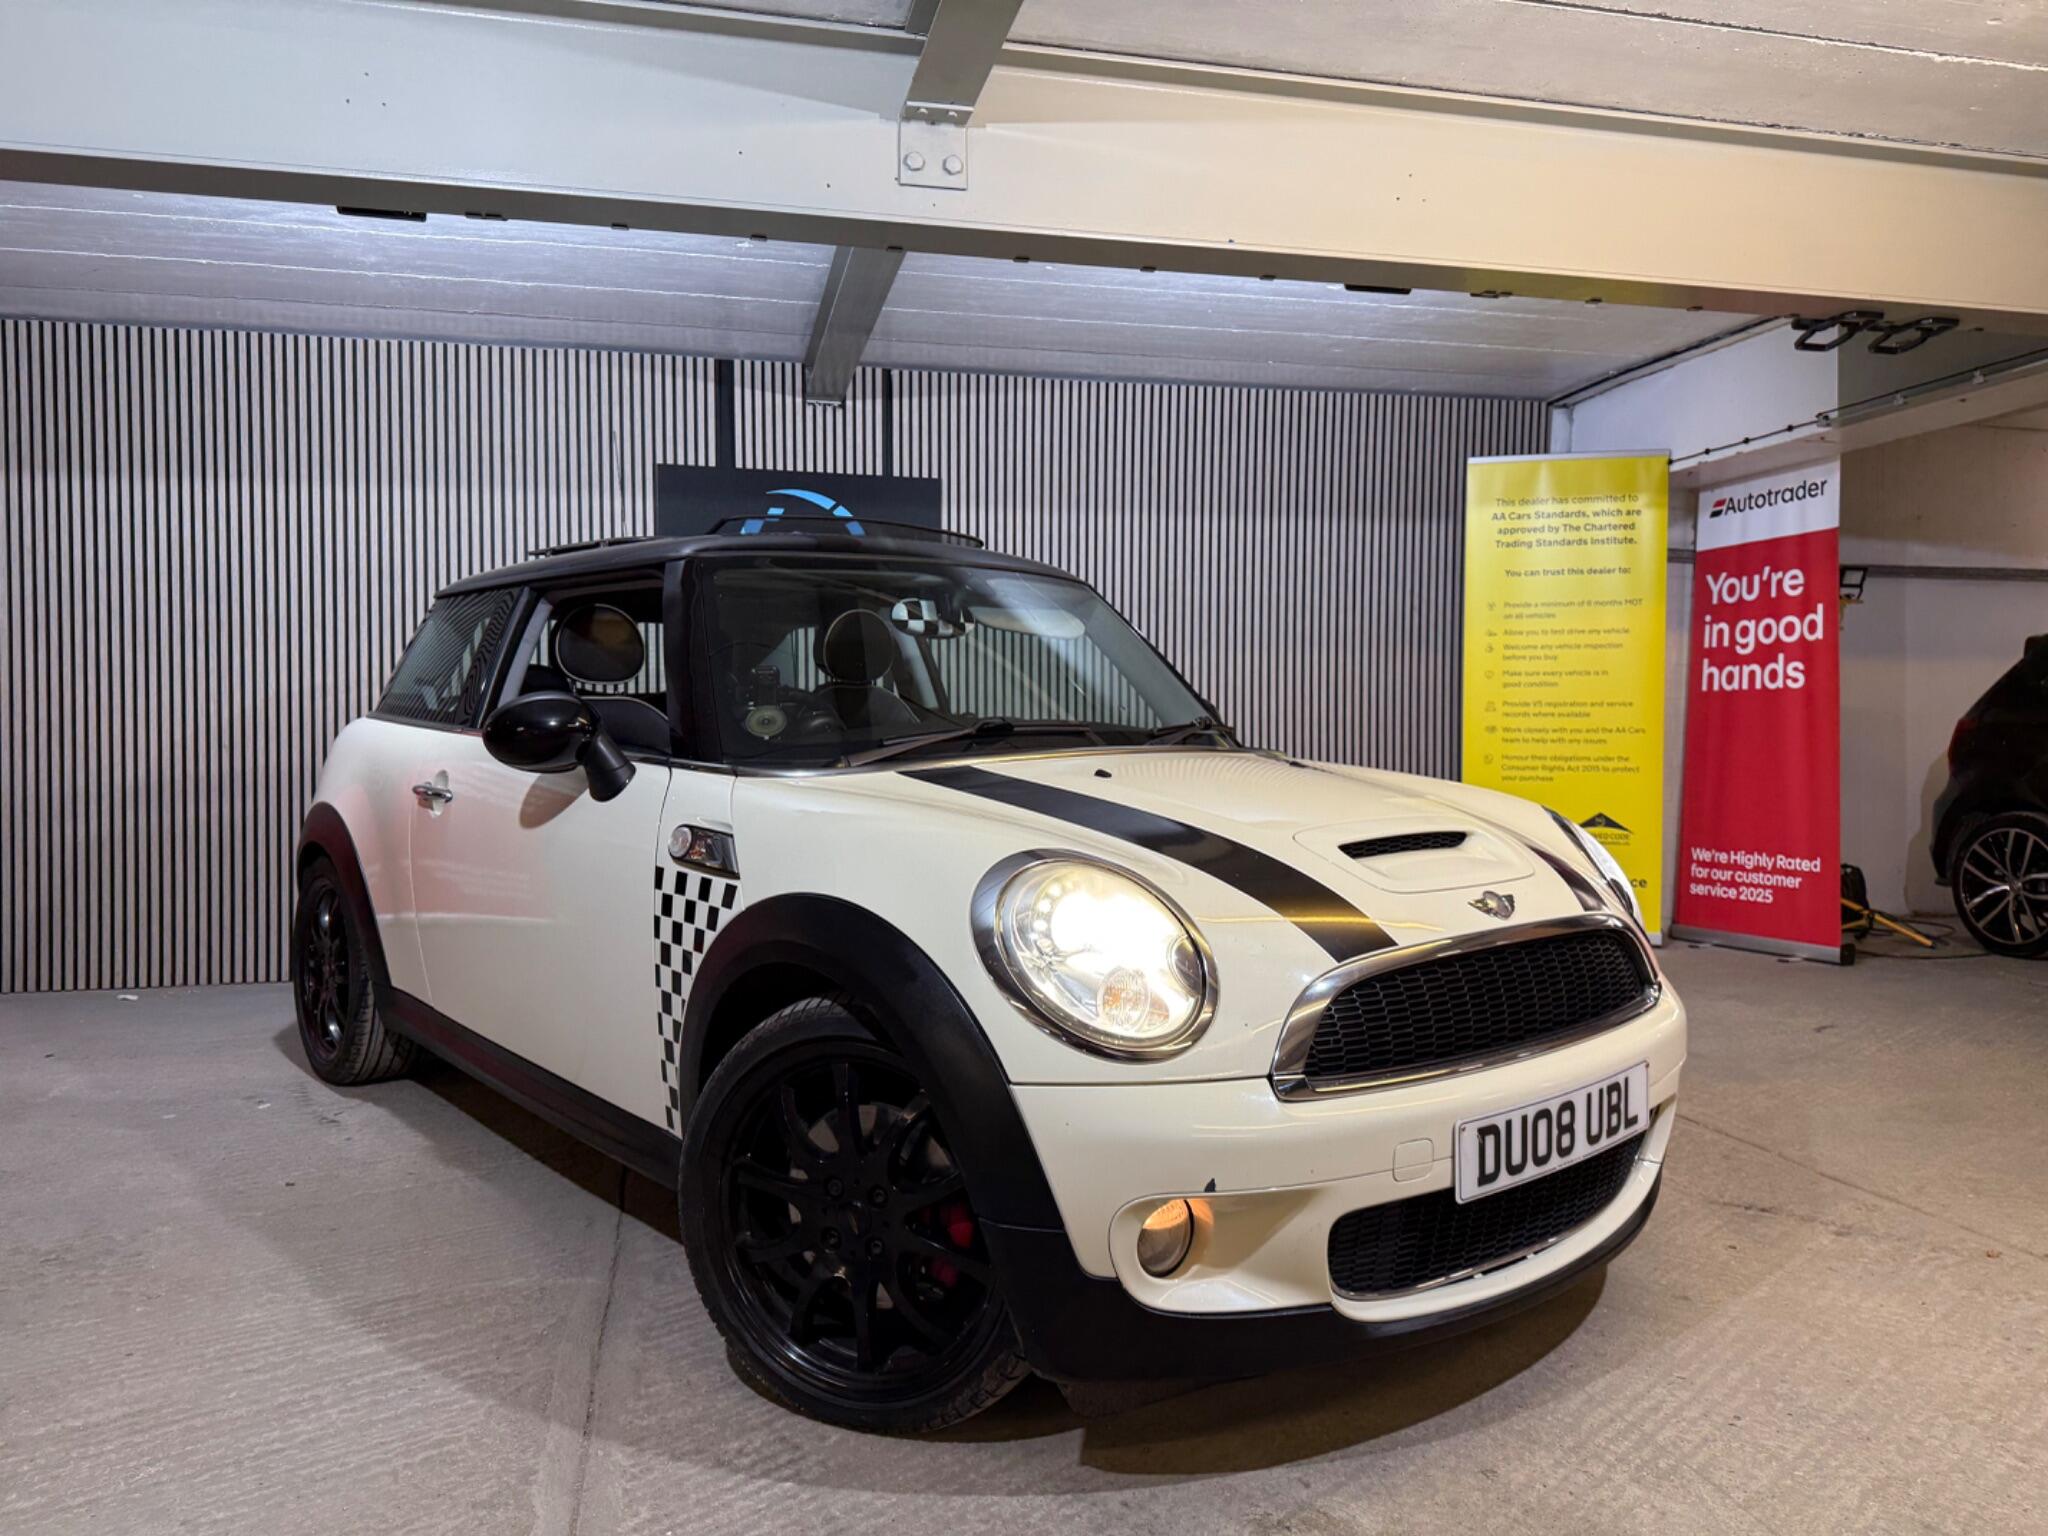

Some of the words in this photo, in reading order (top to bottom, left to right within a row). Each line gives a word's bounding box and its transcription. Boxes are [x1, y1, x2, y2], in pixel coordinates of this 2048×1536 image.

[1496, 498, 1516, 507] This
[1518, 497, 1549, 507] dealer
[1551, 496, 1569, 504] has
[1572, 494, 1626, 503] committed
[1627, 494, 1638, 503] to
[1724, 479, 1828, 515] Autotrader
[1491, 512, 1506, 521] AA
[1508, 511, 1531, 520] Cars
[1534, 510, 1590, 519] Standards,
[1593, 509, 1623, 517] which
[1497, 525, 1545, 535] approved
[1547, 524, 1560, 534] by
[1562, 524, 1581, 532] The
[1584, 522, 1636, 531] Chartered
[1496, 539, 1533, 549] Trading
[1536, 538, 1588, 547] Standards
[1590, 536, 1637, 545] Institute.
[1505, 569, 1521, 578] You
[1543, 568, 1565, 576] trust
[1567, 567, 1585, 575] this
[1587, 566, 1616, 575] dealer
[1705, 566, 1805, 605] You're
[1704, 614, 1729, 648] in
[1735, 603, 1824, 654] good
[1702, 653, 1805, 692] hands
[1691, 847, 1728, 863] We're
[1730, 851, 1774, 870] Highly
[1776, 855, 1821, 872] Rated
[1691, 864, 1709, 878] for
[1711, 869, 1733, 881] our
[1735, 870, 1802, 889] customer
[1689, 882, 1738, 899] service
[1739, 887, 1773, 903] 2025
[1477, 1100, 1575, 1187] DU08
[1586, 1076, 1638, 1146] UBL
